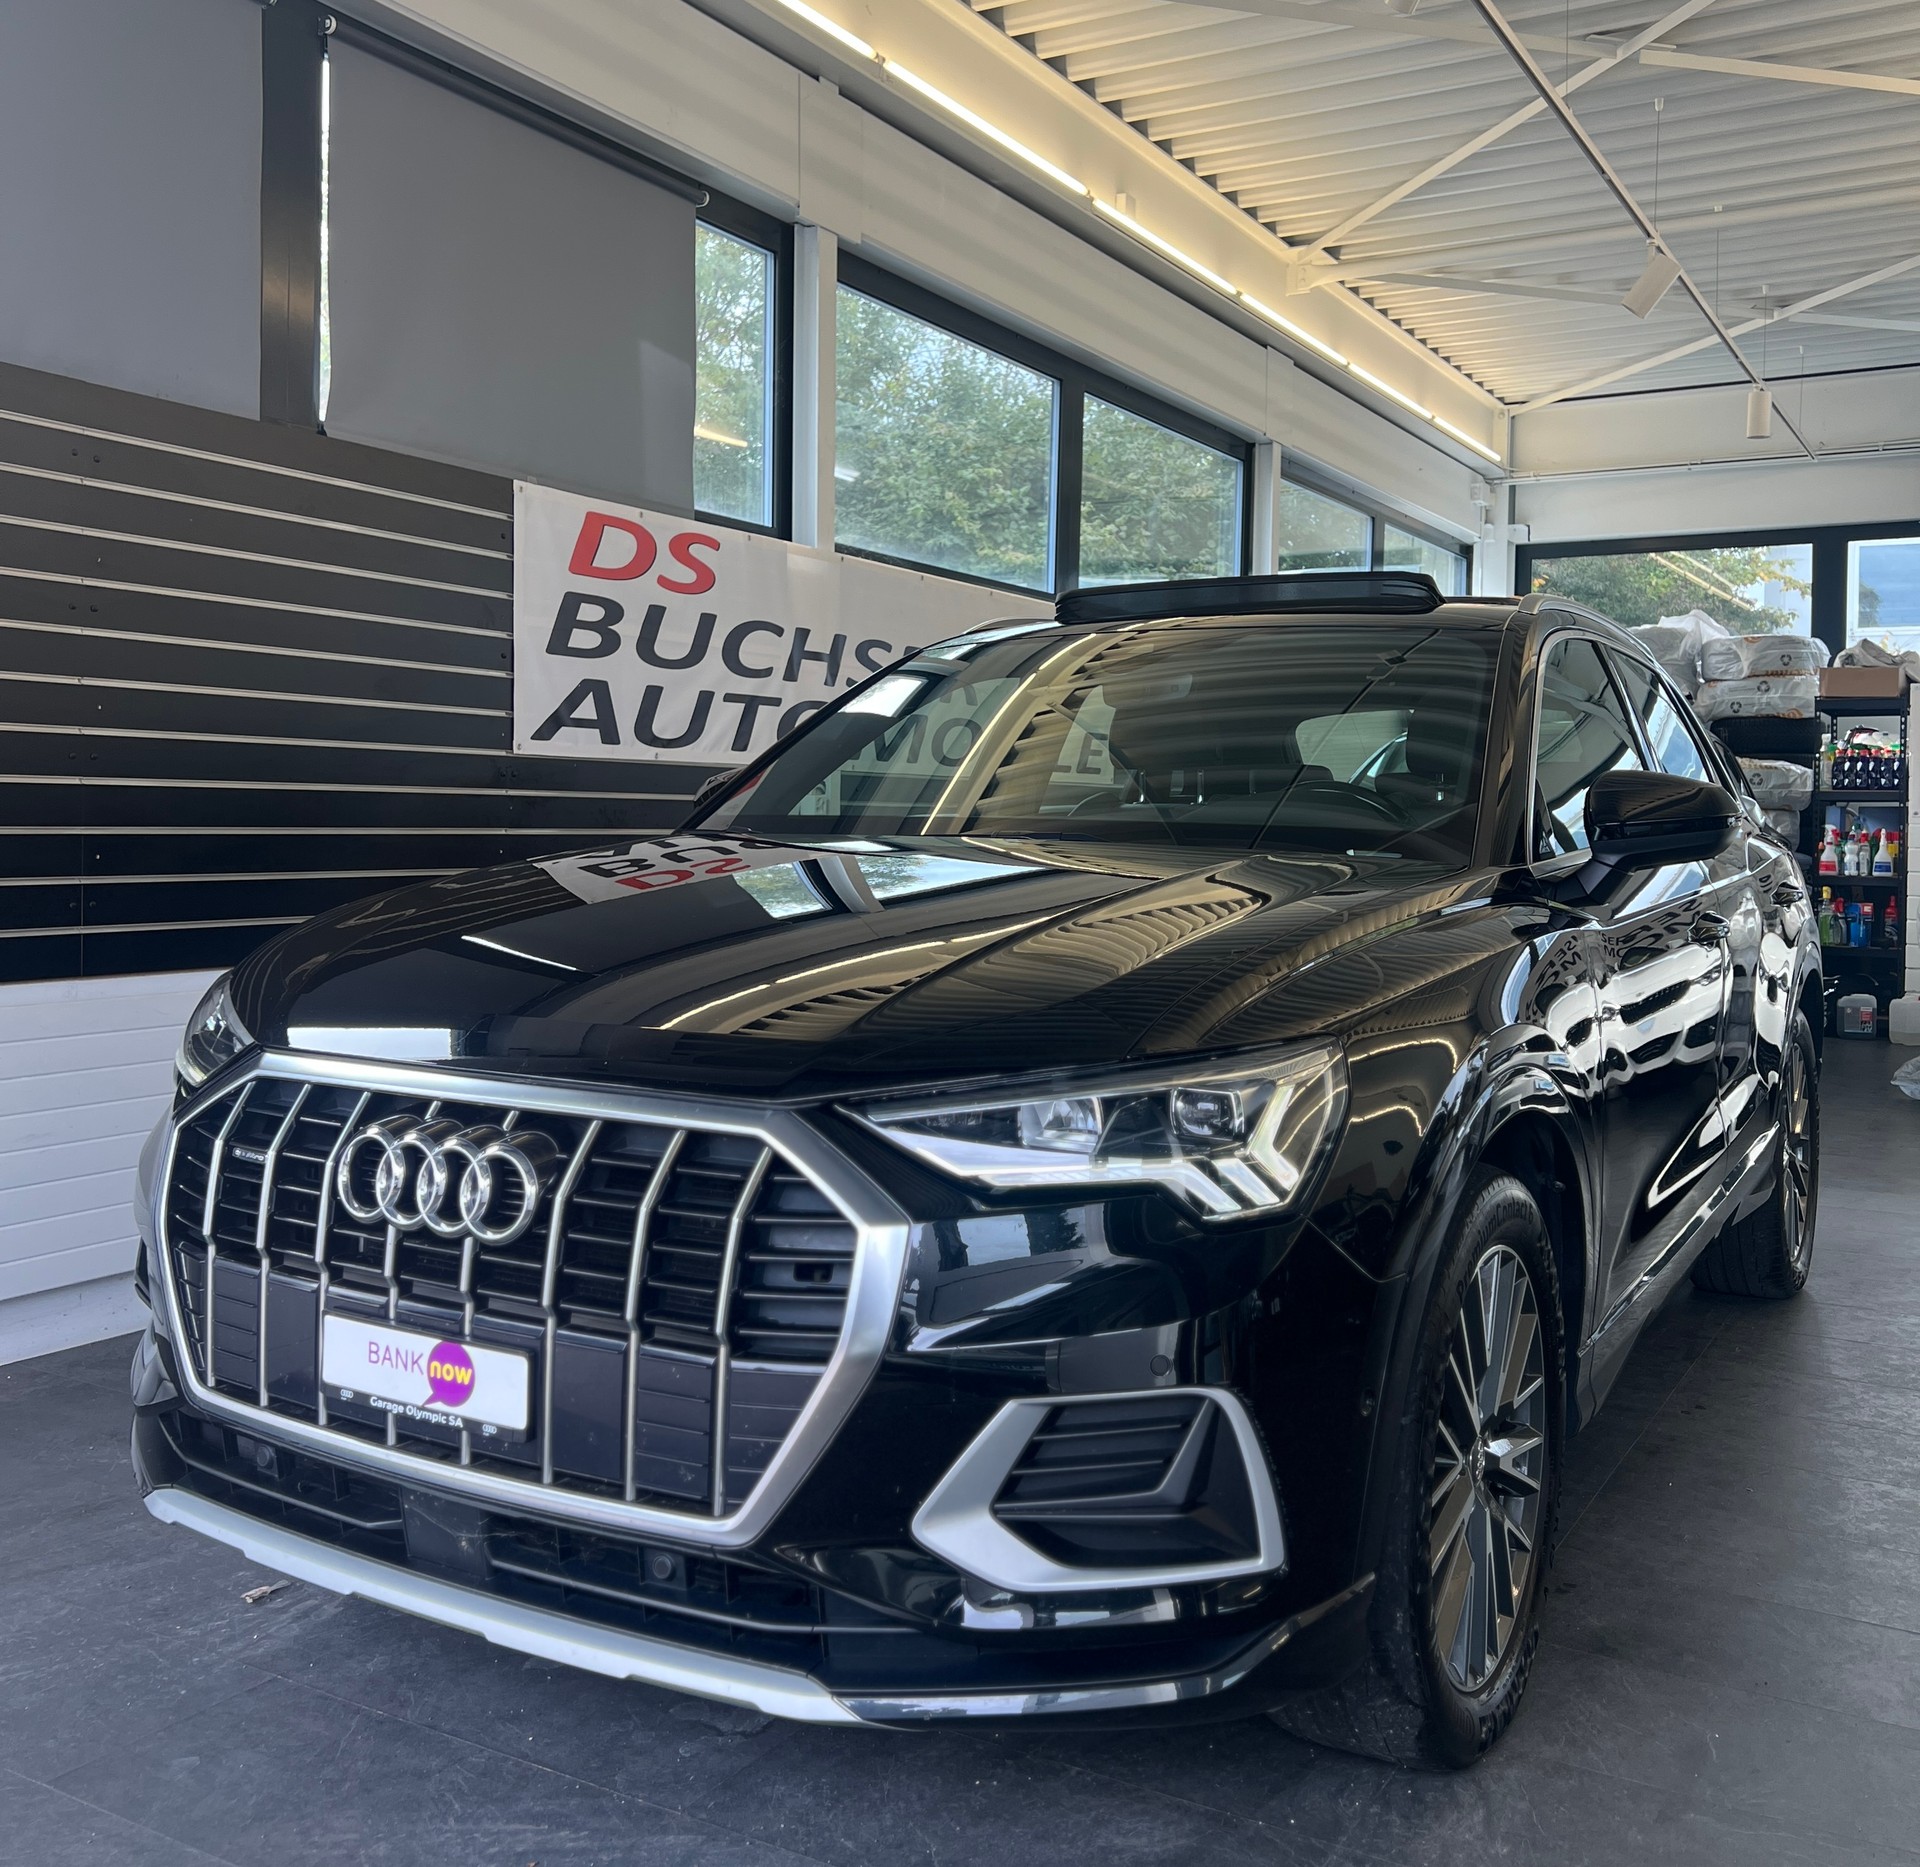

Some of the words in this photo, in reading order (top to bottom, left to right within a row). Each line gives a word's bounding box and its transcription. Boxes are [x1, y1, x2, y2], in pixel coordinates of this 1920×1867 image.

[568, 510, 721, 595] DS
[545, 591, 922, 688] BUCHS
[368, 1341, 424, 1375] BANK
[430, 1360, 473, 1385] now
[369, 1396, 404, 1415] Garage
[406, 1405, 447, 1426] Olympic
[448, 1415, 464, 1428] SA
